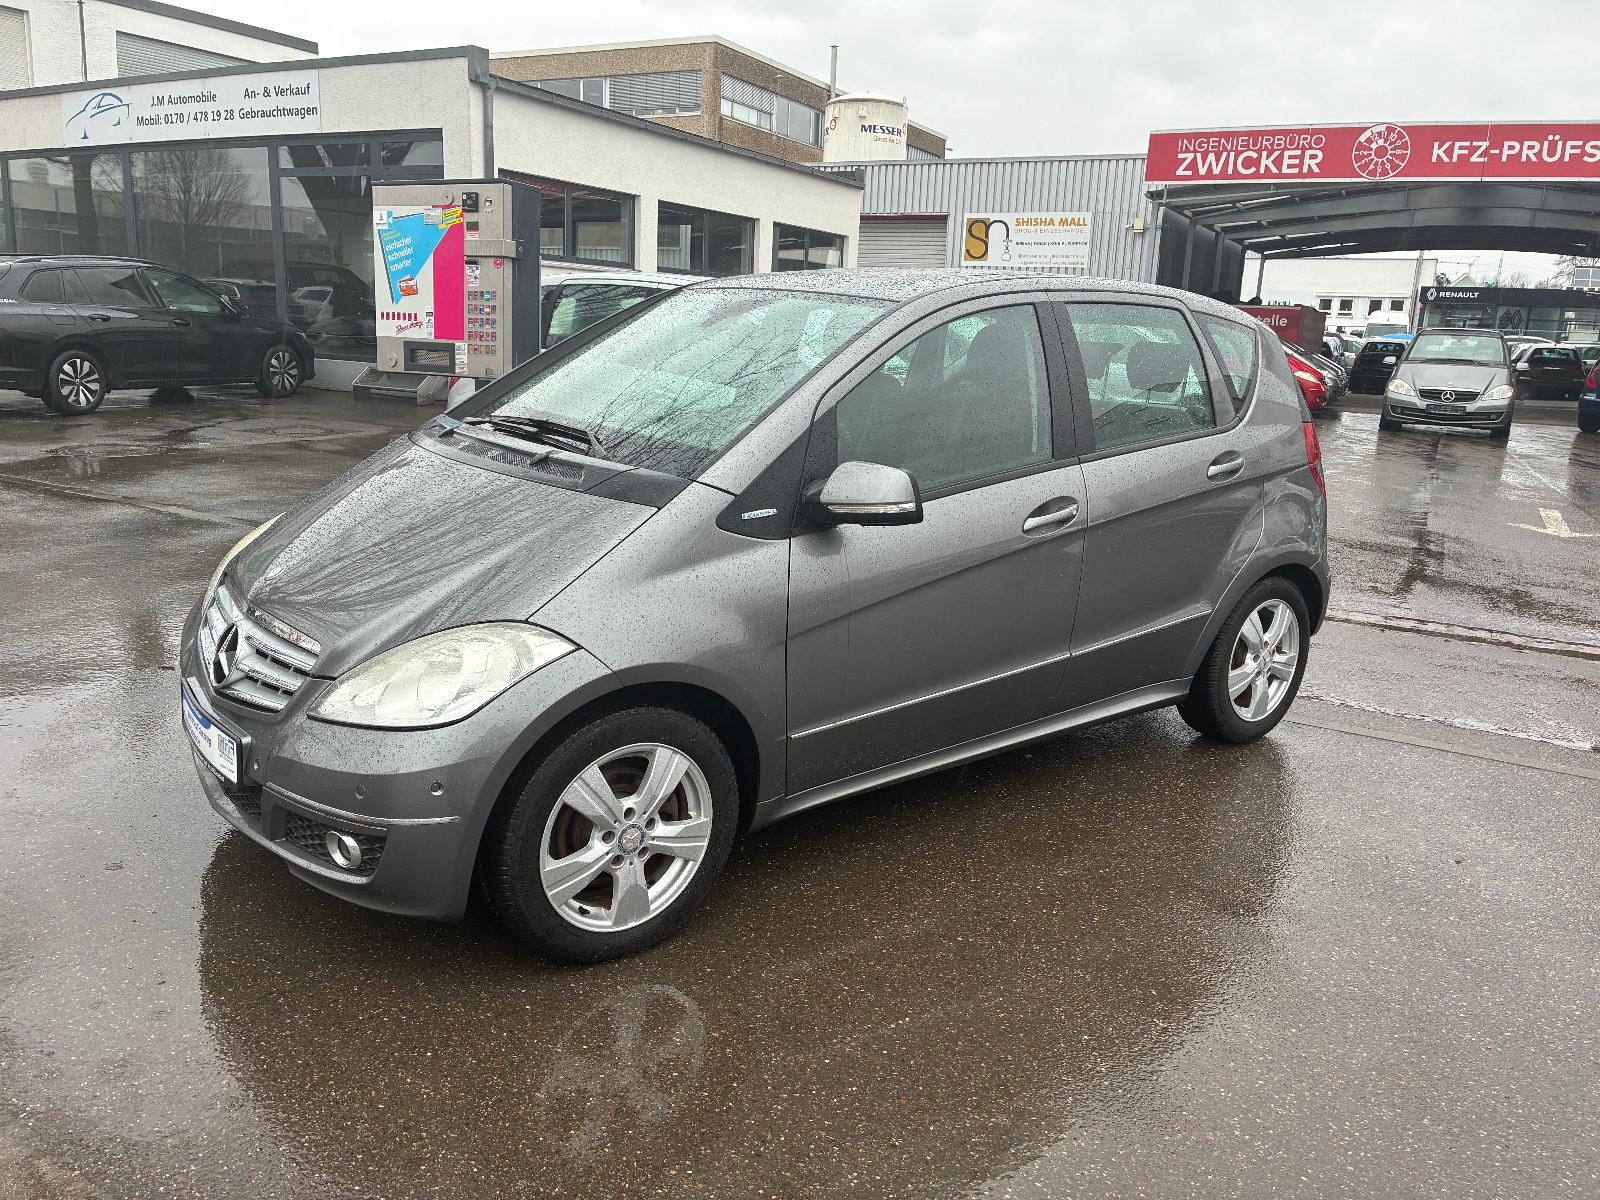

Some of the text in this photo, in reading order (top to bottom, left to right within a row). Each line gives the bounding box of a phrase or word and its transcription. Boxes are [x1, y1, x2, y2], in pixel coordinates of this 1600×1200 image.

[150, 91, 217, 108] J.M Automobile
[244, 83, 311, 100] An- & Verkauf
[136, 109, 235, 127] Mobil: 0170 / 478 19 28
[238, 105, 318, 121] Gebrauchtwagen
[861, 124, 902, 137] MESSER
[1177, 133, 1326, 152] INGENIEURBÜRO
[1431, 134, 1600, 163] KFZ-PRÜFS
[1175, 150, 1324, 176] ZWICKER
[1015, 217, 1088, 227] SHISHA MALL
[385, 236, 412, 252] einfacher
[388, 246, 414, 261] schneller
[390, 259, 412, 272] smarter
[1439, 291, 1480, 299] RENAULT
